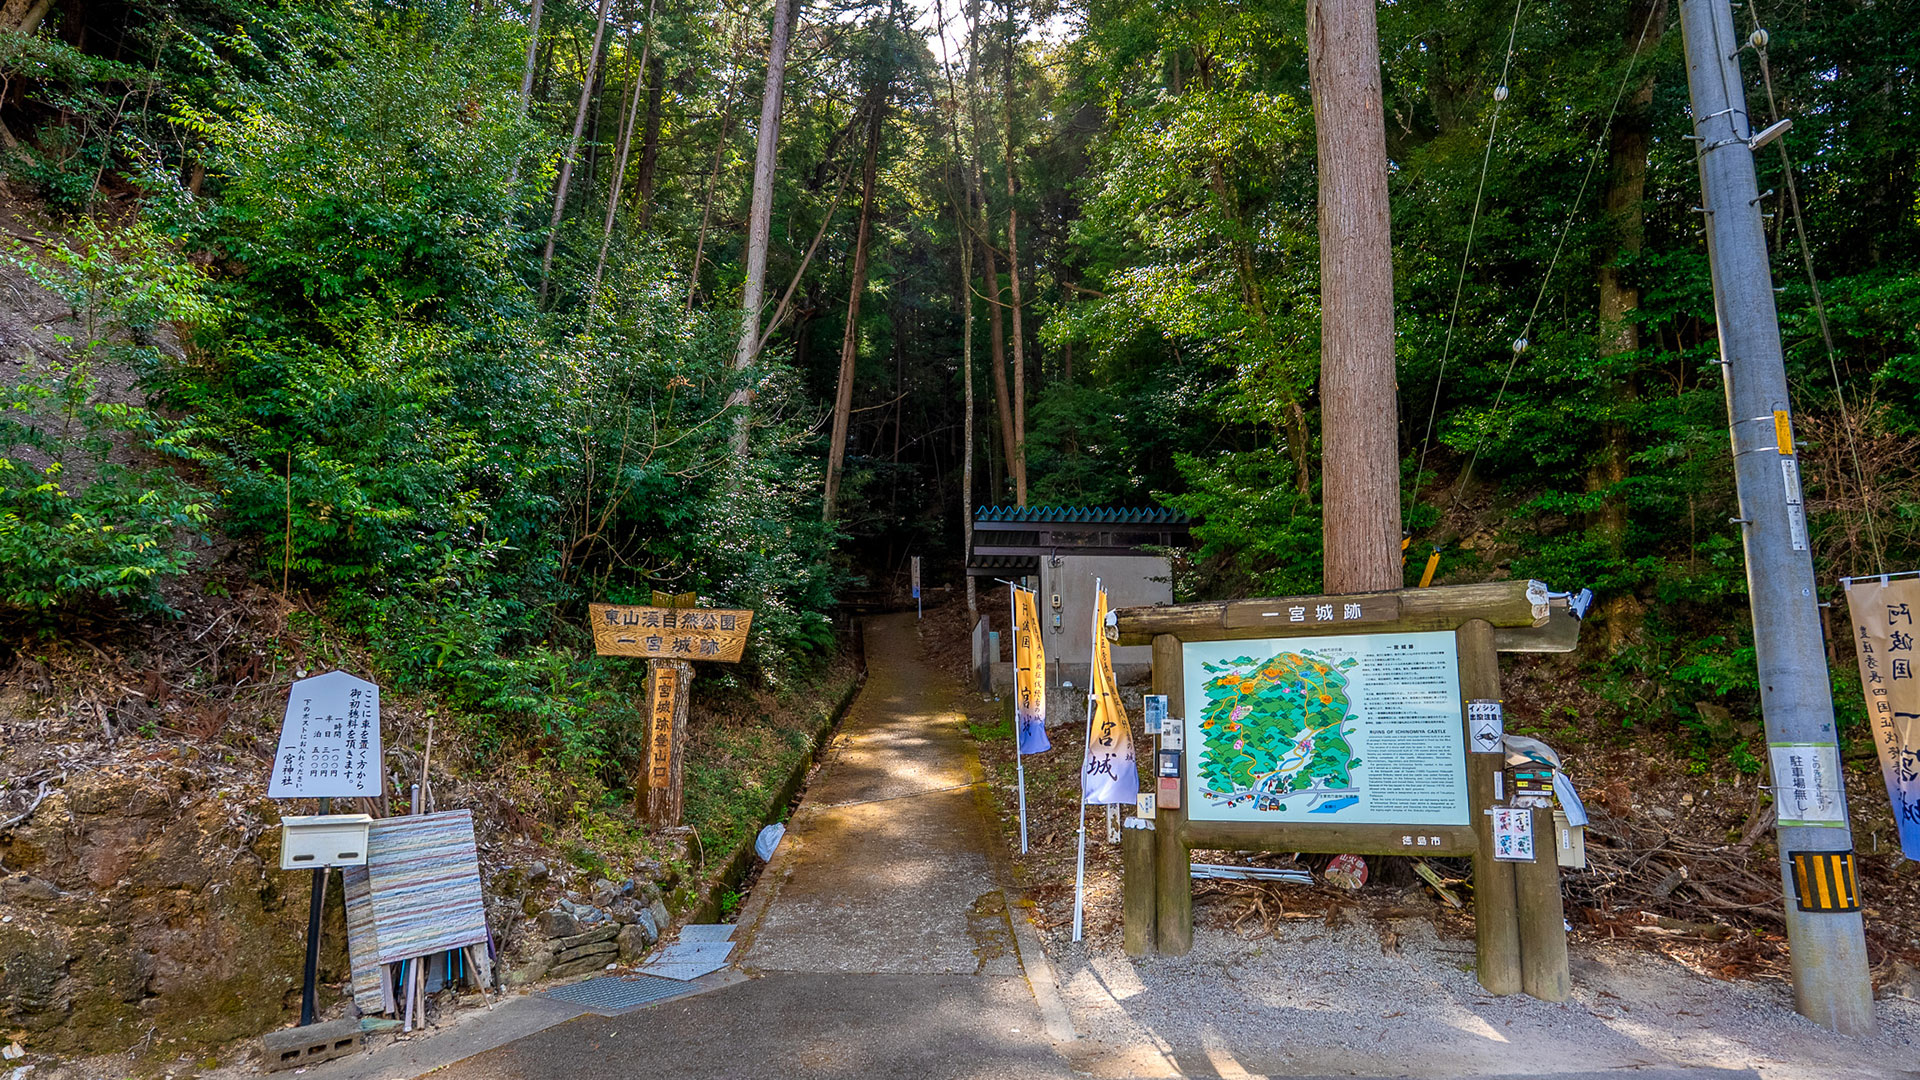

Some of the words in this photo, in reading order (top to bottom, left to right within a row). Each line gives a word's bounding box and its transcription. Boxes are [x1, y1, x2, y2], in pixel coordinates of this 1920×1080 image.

[1261, 602, 1362, 623] 一宮城跡
[617, 634, 721, 656] 一宮城跡
[1469, 705, 1496, 713] イノシシ
[314, 717, 322, 738] 一泊
[333, 716, 344, 739] 一時間
[343, 688, 362, 784] 御初穂料を頂きます。
[356, 689, 372, 791] ここに車を置く方から
[653, 675, 673, 778] 一宮城跡登山口
[295, 698, 312, 792] 下のポストにお入れください。
[281, 745, 297, 787] 一宮神社
[1789, 754, 1809, 812] 駐車場無し
[1401, 835, 1441, 847] 徳島市
